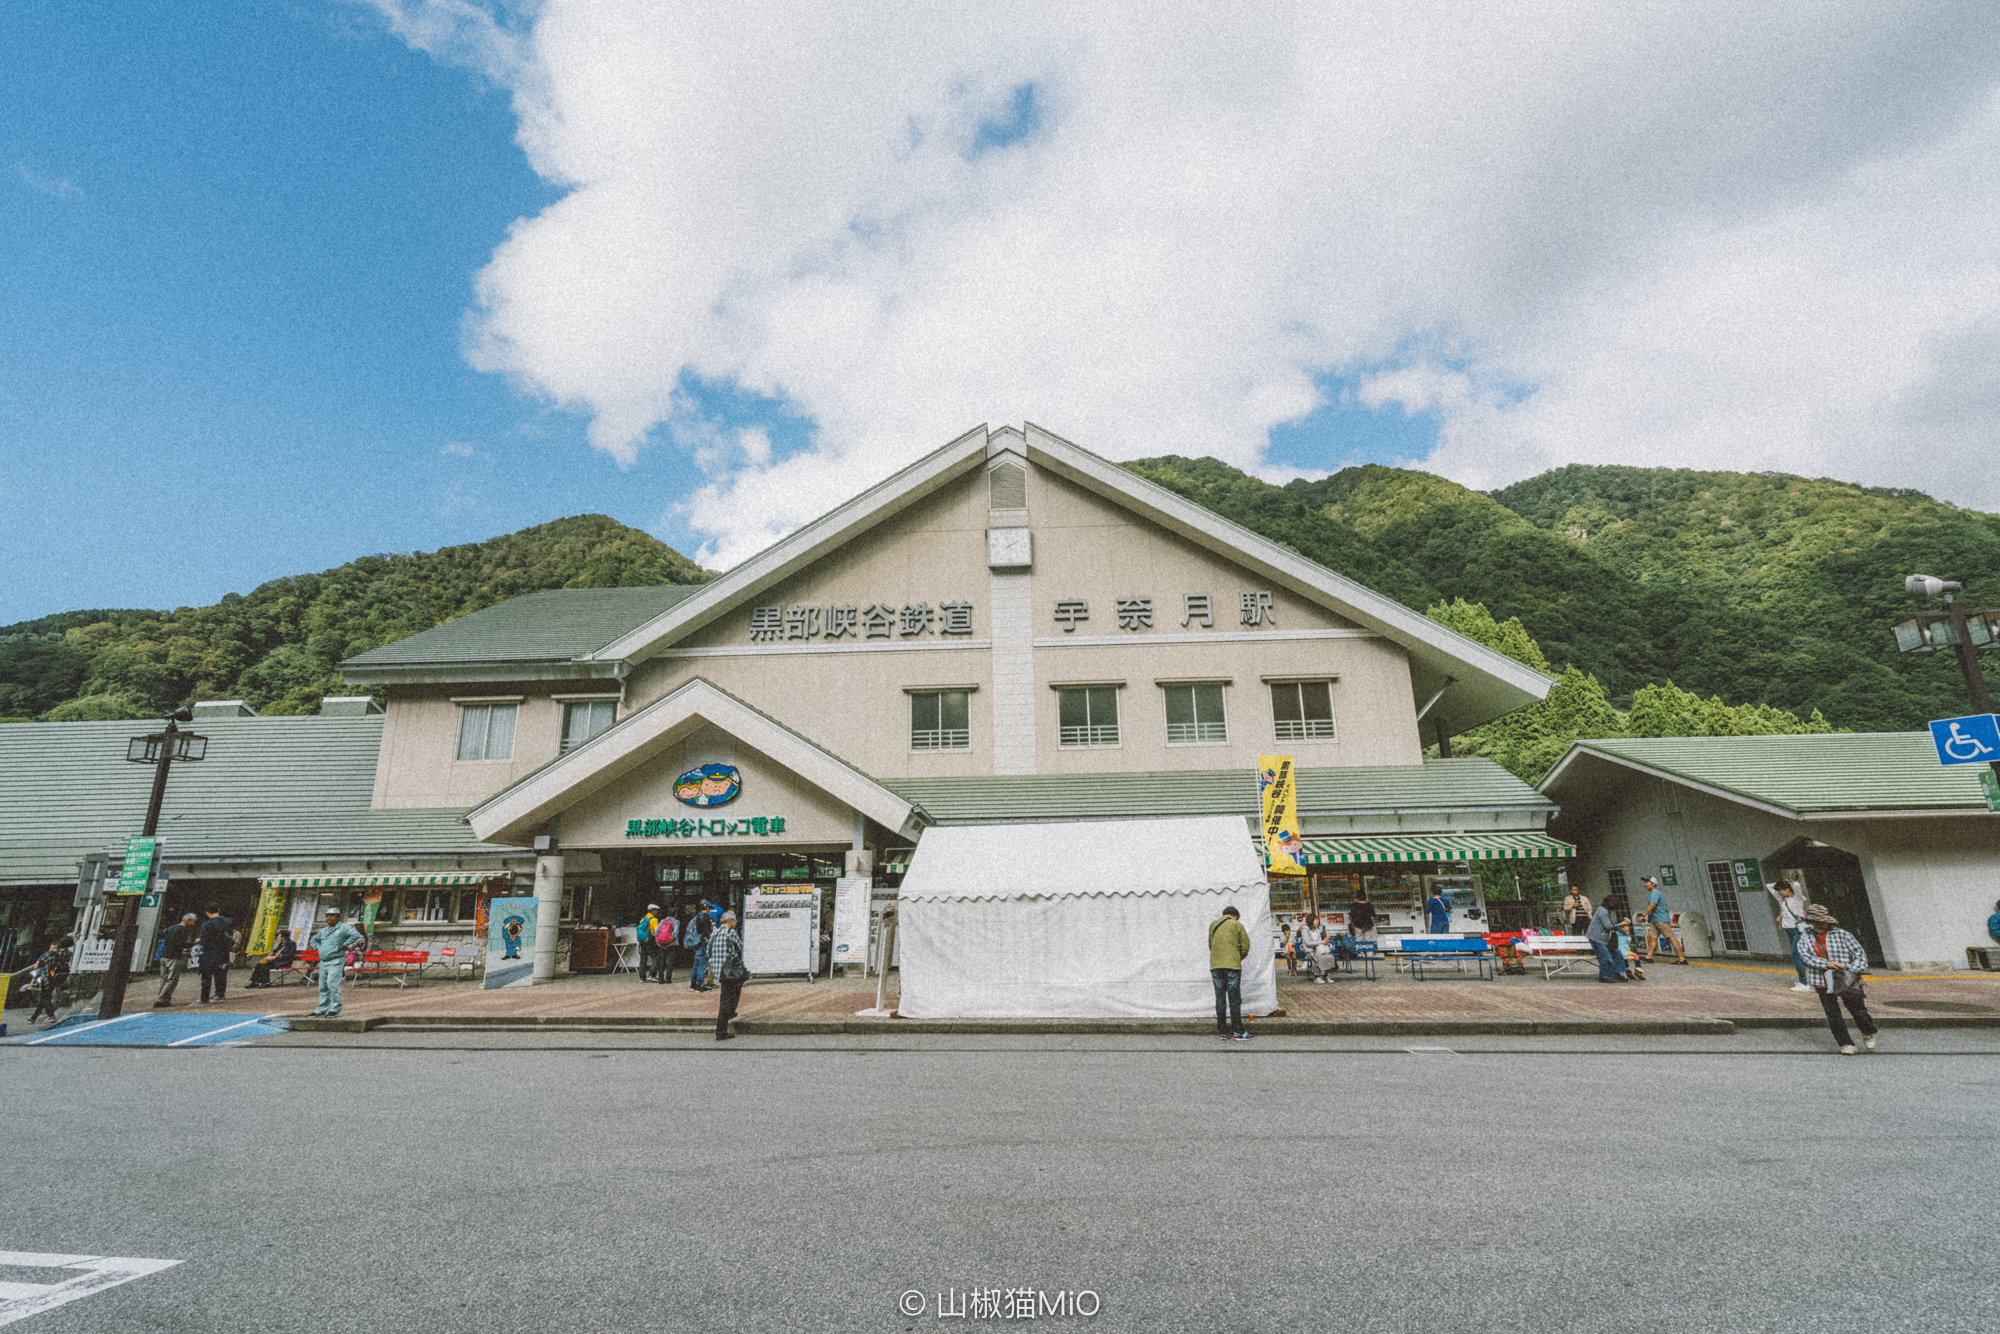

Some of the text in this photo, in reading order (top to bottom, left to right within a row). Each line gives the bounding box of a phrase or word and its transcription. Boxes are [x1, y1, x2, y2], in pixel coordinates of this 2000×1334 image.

[750, 590, 1275, 640] 黒部峡谷鉄道 宇奈月駅
[1271, 761, 1291, 799] 黒部峡谷
[625, 816, 786, 838] 黒部峡谷トロッコ電車
